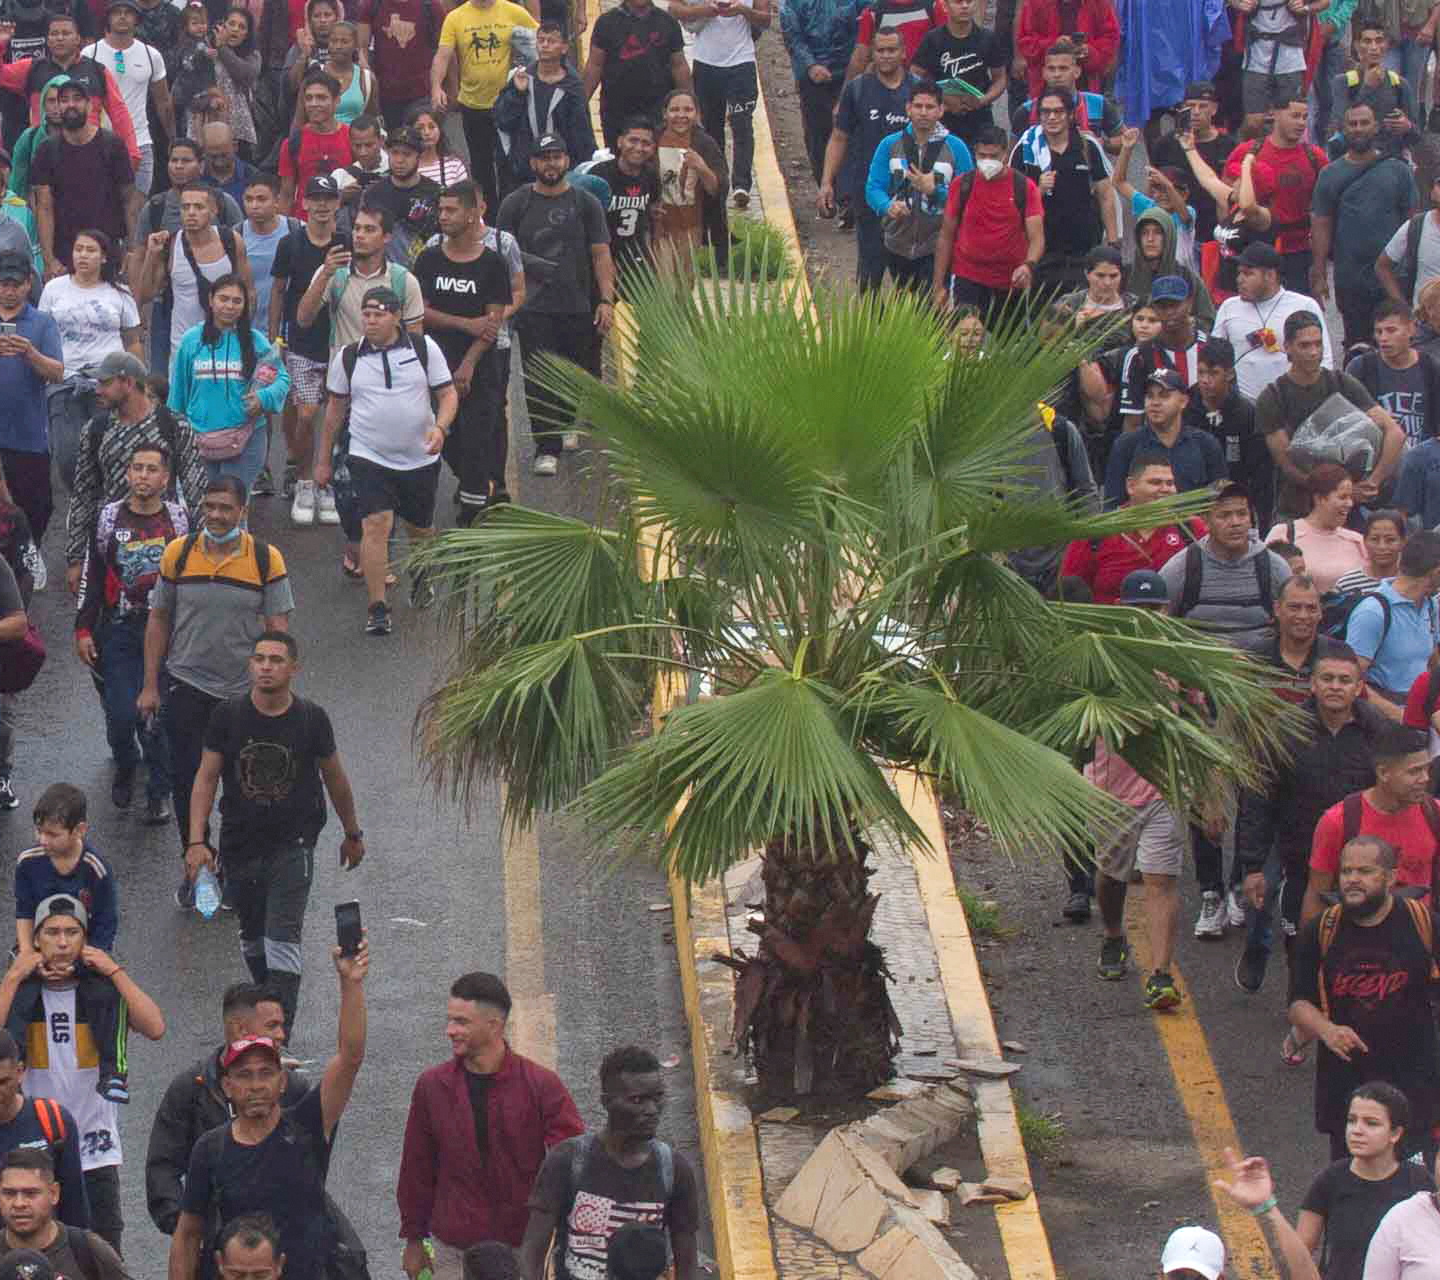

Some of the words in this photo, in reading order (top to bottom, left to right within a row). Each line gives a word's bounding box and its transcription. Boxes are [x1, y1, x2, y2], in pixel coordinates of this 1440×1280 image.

[617, 209, 638, 237] 3
[435, 276, 478, 294] NASA
[50, 1011, 71, 1044] STB
